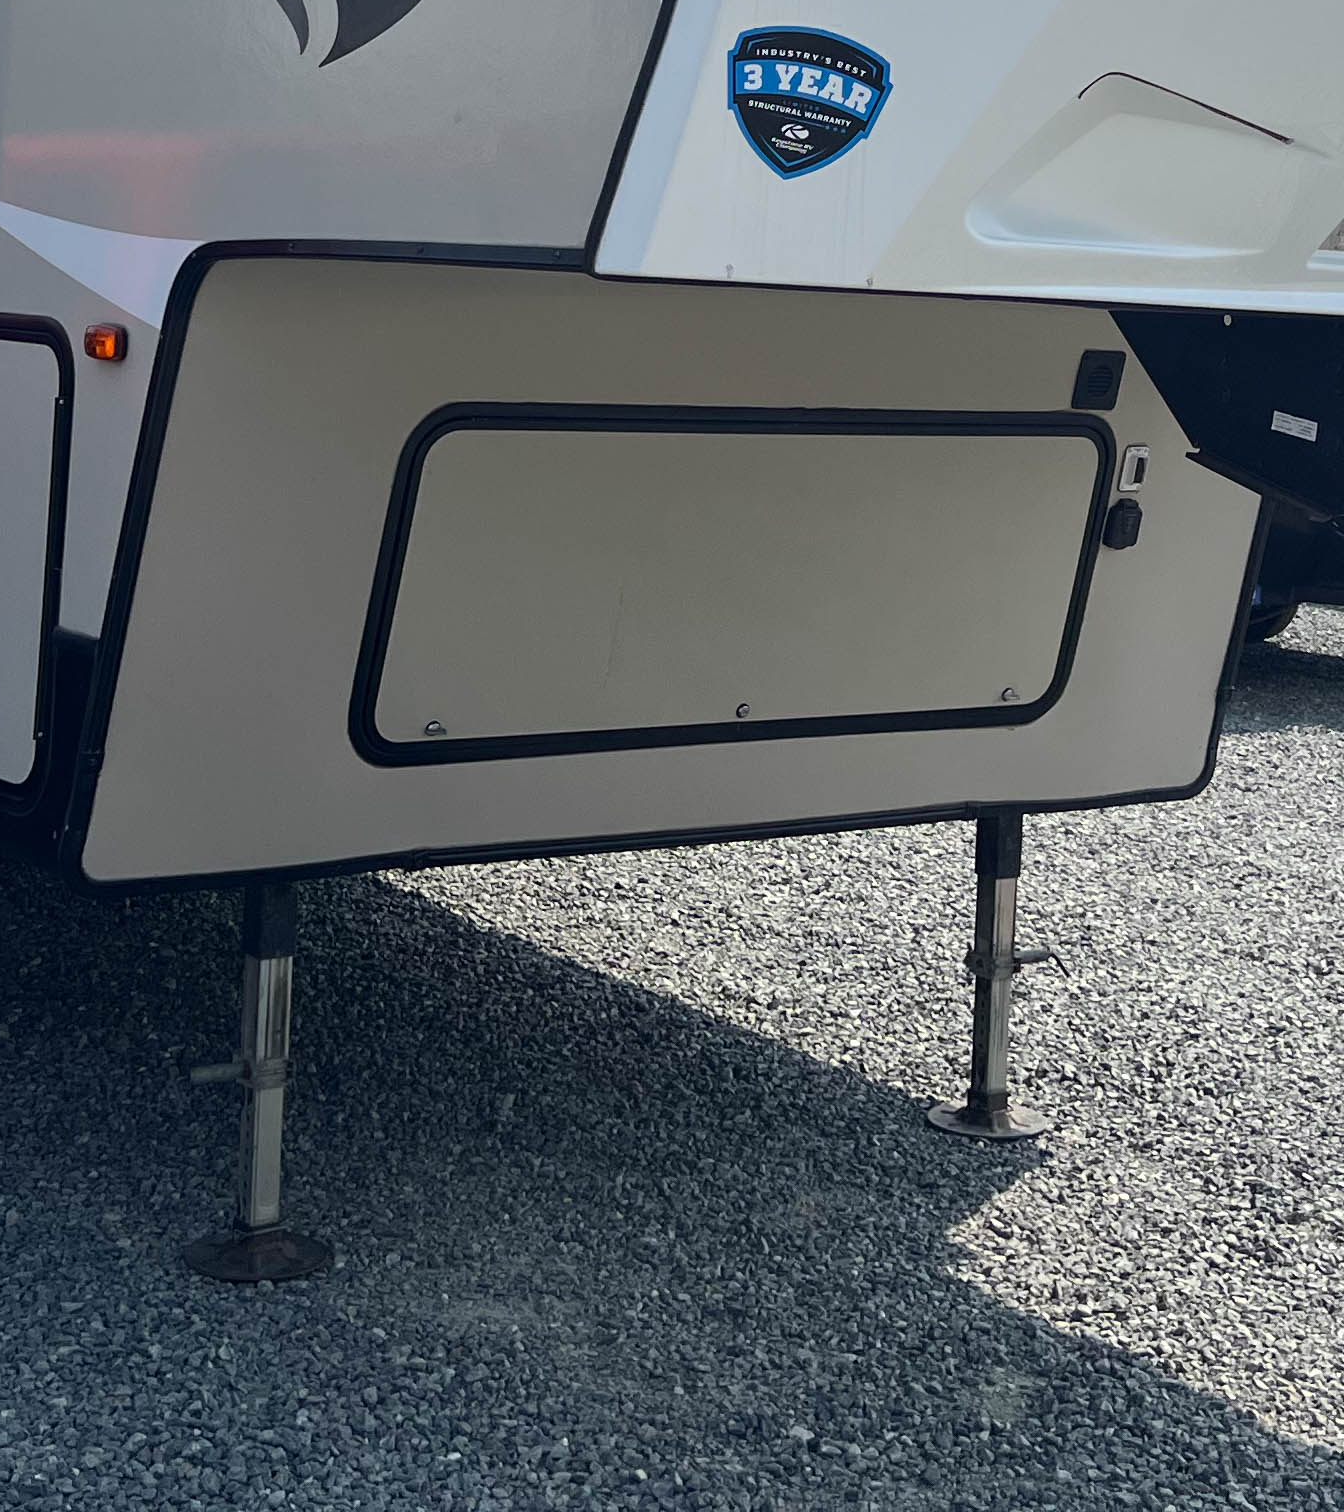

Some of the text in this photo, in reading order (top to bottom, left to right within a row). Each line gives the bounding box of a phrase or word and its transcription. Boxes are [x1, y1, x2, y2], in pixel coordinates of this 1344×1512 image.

[756, 48, 867, 77] INDUSTRY'S BEST
[743, 64, 873, 114] 3 YEAR
[748, 99, 852, 128] STRUCTURAL WARRANTY
